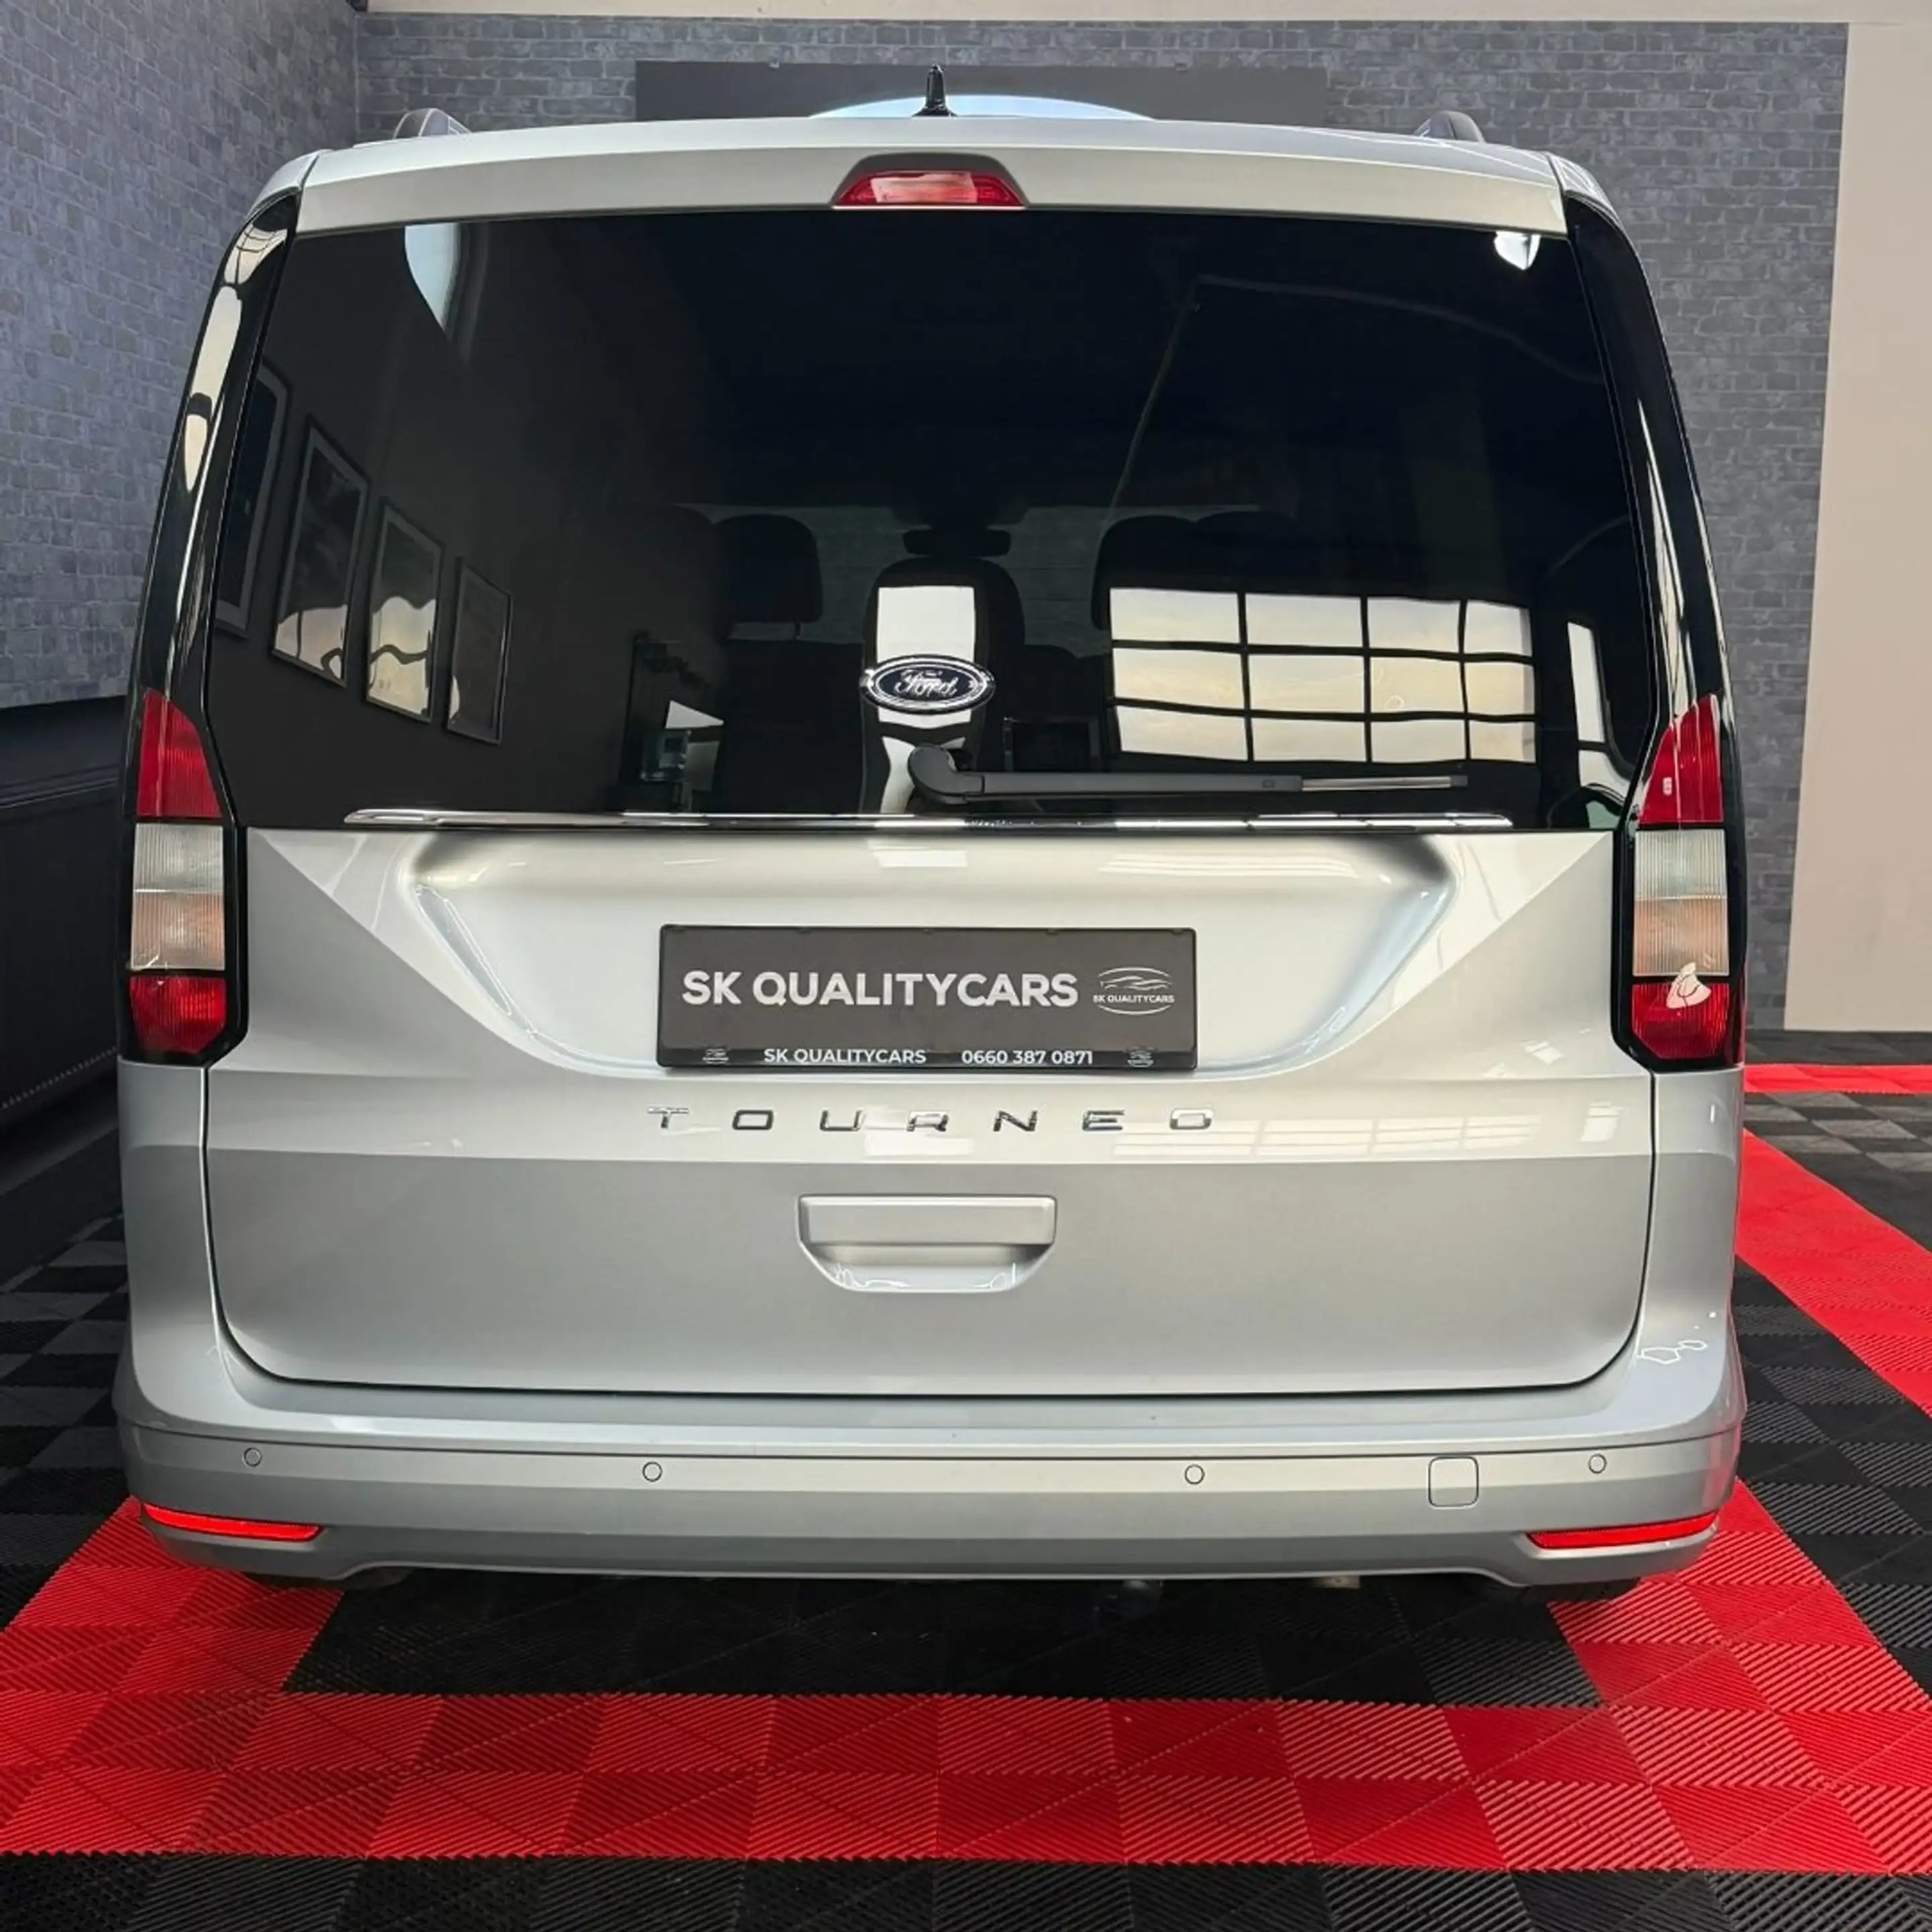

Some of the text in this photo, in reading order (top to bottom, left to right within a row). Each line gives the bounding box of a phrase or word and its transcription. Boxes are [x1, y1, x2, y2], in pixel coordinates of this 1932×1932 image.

[894, 669, 959, 698] Ford
[682, 971, 1079, 1007] SK QUALITYCARS
[1093, 994, 1175, 1004] SK QUALITYCARS
[763, 1048, 927, 1065] SK QUALITYCARS
[961, 1050, 1093, 1065] 0660 387 0871
[647, 1106, 1215, 1132] TOURNEO
